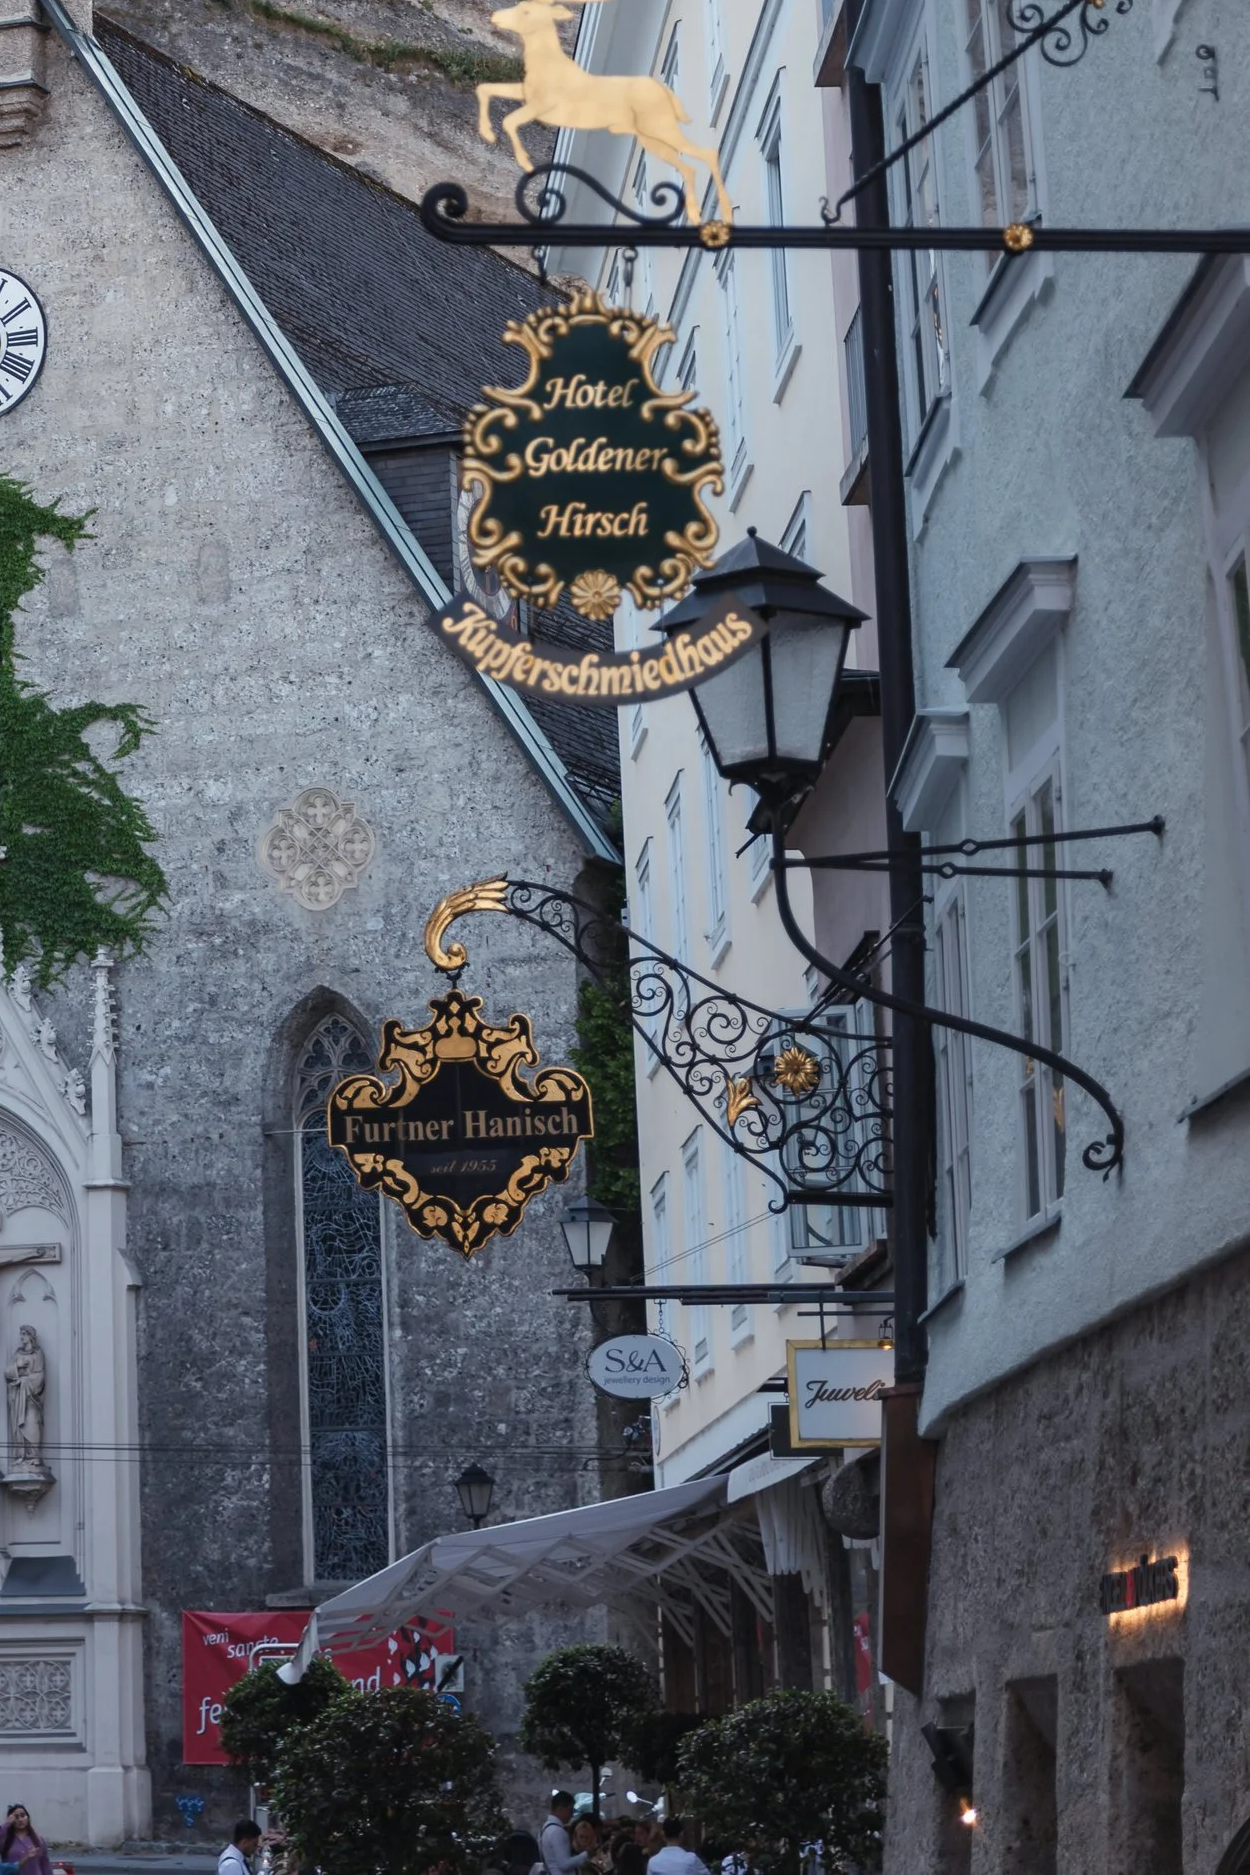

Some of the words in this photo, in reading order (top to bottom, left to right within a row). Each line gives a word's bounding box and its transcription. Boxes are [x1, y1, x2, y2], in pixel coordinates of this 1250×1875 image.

[542, 373, 640, 411] Hotel
[524, 436, 668, 477] Goldener
[537, 501, 649, 538] Hirsch
[443, 602, 754, 696] Kupferschmiedhaus
[344, 1115, 455, 1143] Furtner
[463, 1107, 579, 1139] Hanisch
[460, 1159, 498, 1173] 1955
[604, 1348, 667, 1373] S&A
[603, 1376, 641, 1385] jewellery
[643, 1376, 671, 1385] design
[203, 1628, 229, 1646] veni
